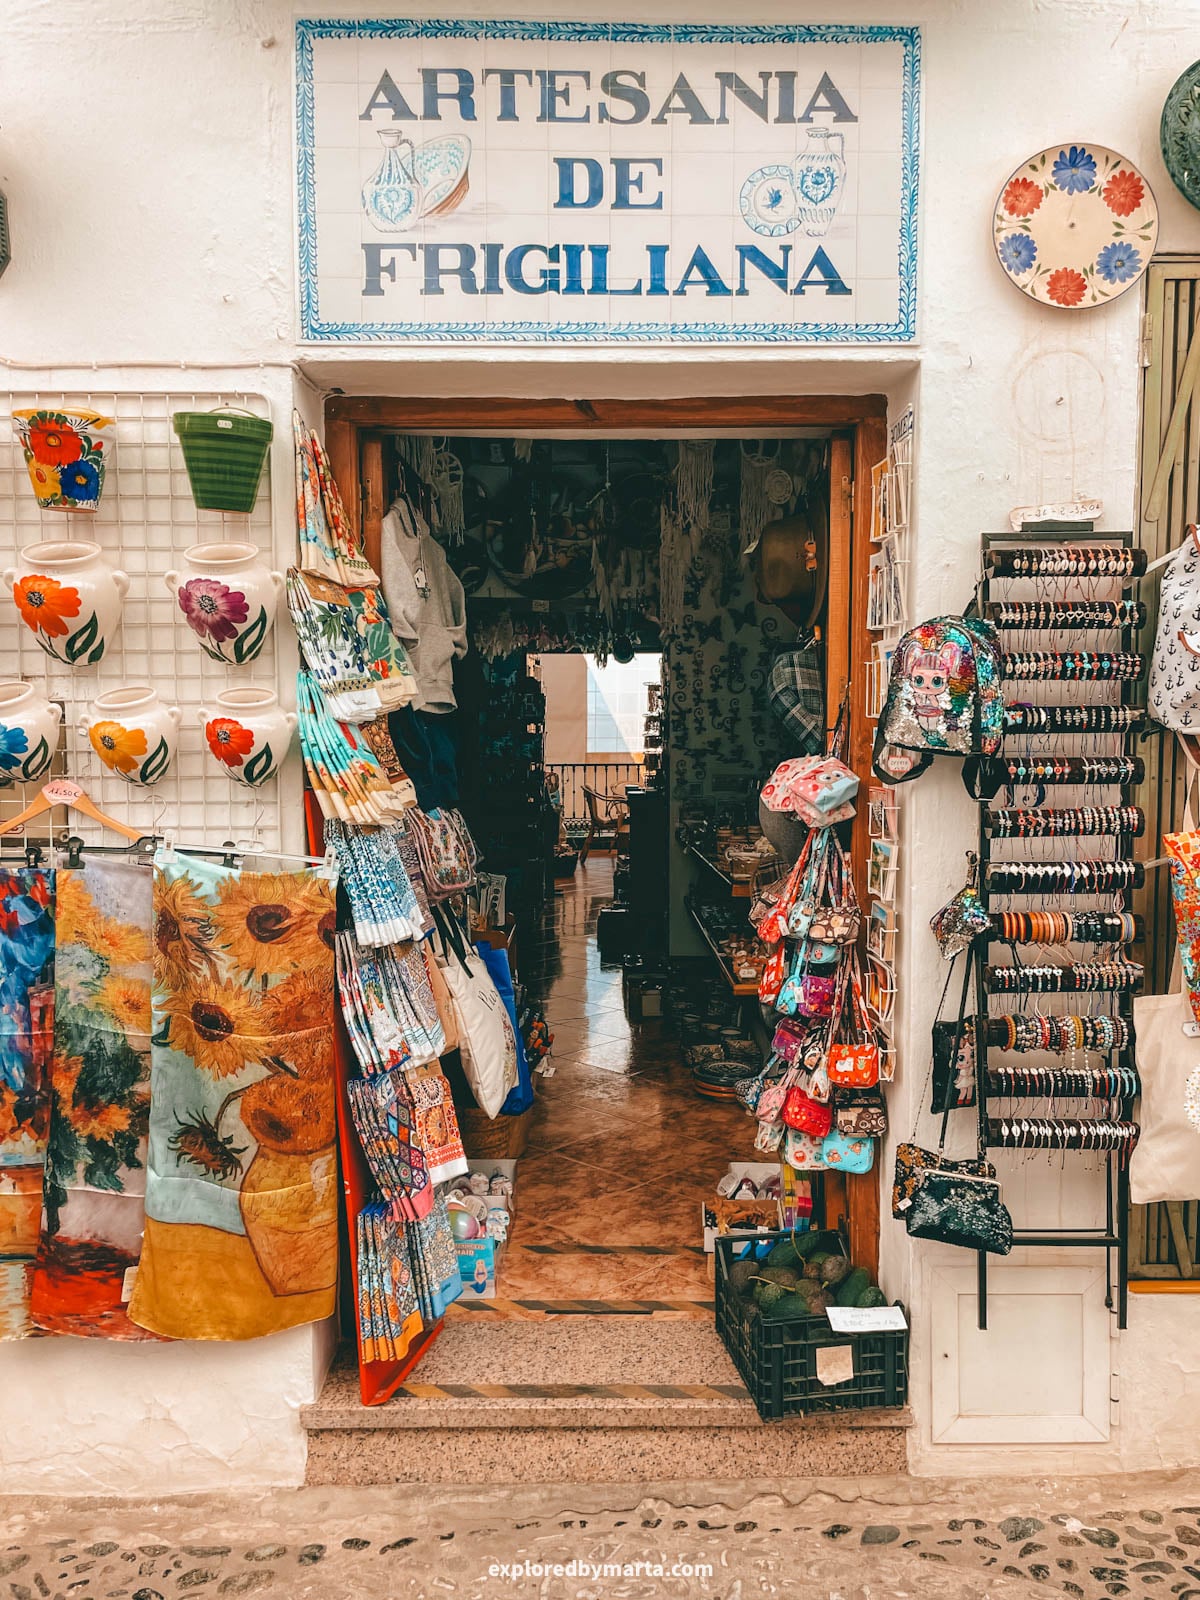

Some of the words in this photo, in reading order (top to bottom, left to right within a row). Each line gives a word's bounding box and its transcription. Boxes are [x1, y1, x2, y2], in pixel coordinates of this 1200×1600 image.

[358, 67, 859, 125] ARTESANIA
[553, 157, 663, 210] DE
[361, 243, 852, 297] FRIGILIANA
